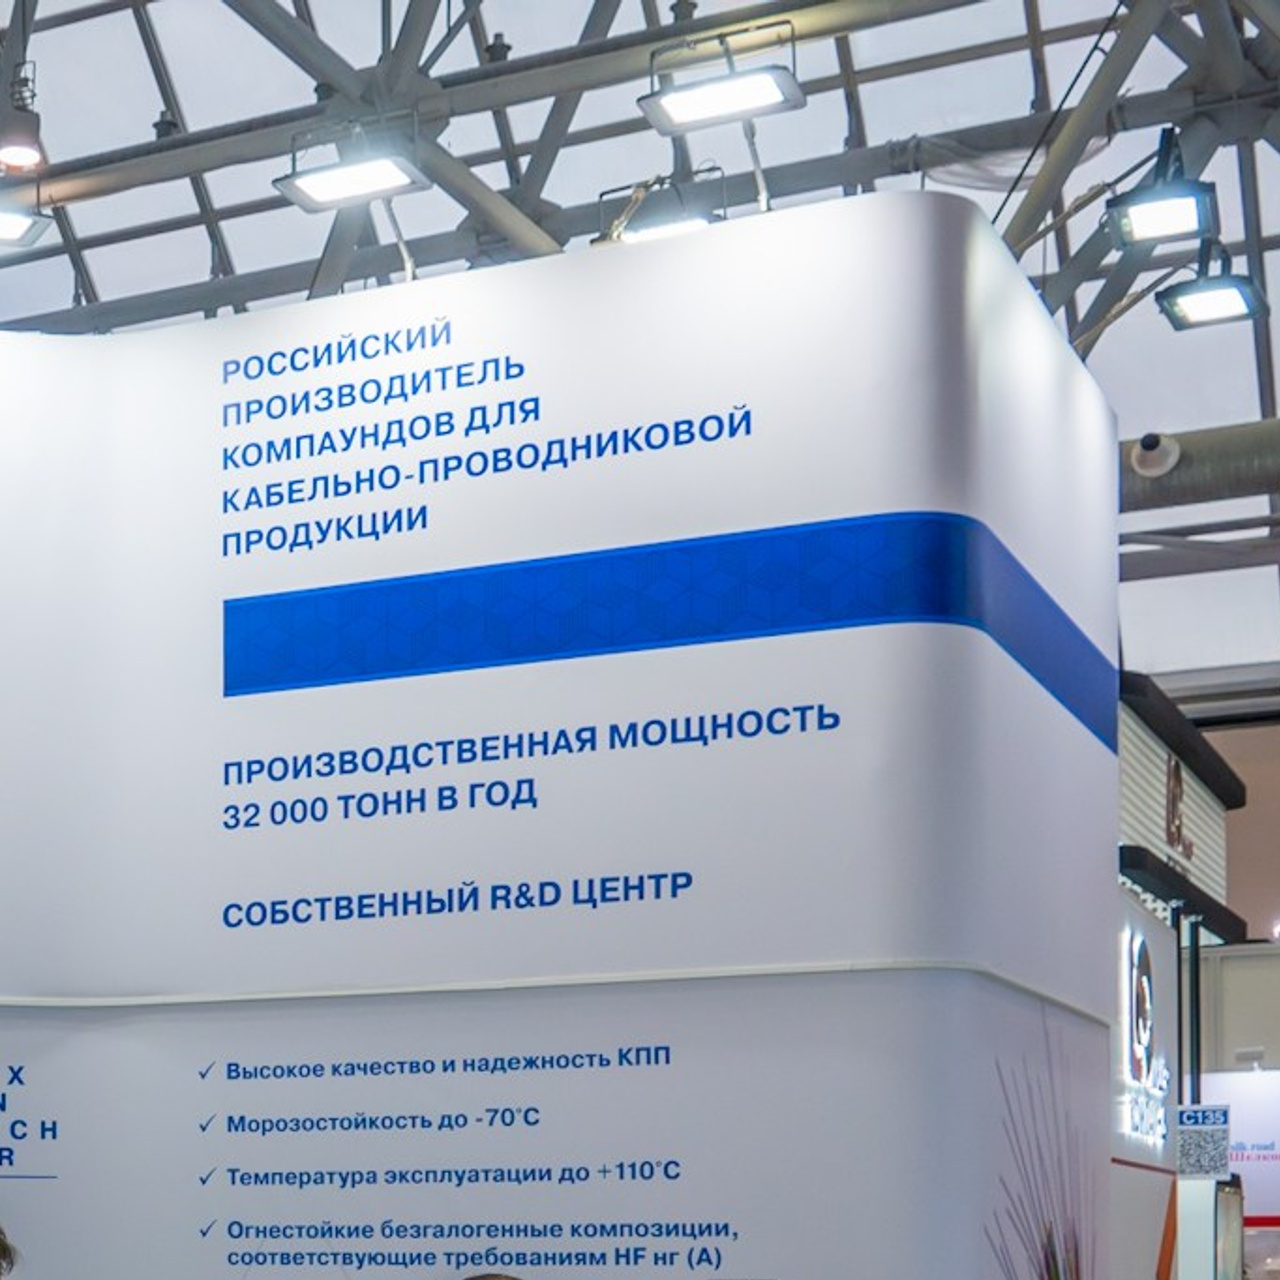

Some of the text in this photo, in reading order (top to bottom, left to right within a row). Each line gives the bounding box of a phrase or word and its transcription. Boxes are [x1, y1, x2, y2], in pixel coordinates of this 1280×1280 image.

[222, 317, 452, 383] РОССИЙСКИЙ
[222, 355, 526, 428] ПРОИЗВОДИТЕЛЬ
[222, 397, 539, 470] КОМПАУНДОВ ДЛЯ
[222, 405, 752, 513] КАБЕЛЬНО-ПРОВОДНИКОВОЙ
[222, 504, 427, 556] ПРОДУКЦИИ
[223, 704, 840, 786] ПРОИЗВОДСТВЕННАЯ МОЩНОСТЬ
[223, 779, 537, 829] 32 000 ТОНН В ГОД
[223, 872, 692, 928] СОБСТВЕННЫЙ R&D ЦЕНТР
[227, 1046, 670, 1080] Высокое качество и надежность КПП
[227, 1113, 432, 1136] Морозостойкость
[438, 1114, 468, 1131] до
[227, 1168, 377, 1189] Температура
[384, 1168, 552, 1187] эксплуатации
[558, 1167, 589, 1184] до
[227, 1219, 738, 1241] Огнестойкие безгалогенные композиции,
[227, 1252, 437, 1270] соответствующие
[443, 1247, 606, 1270] требованиям
[615, 1247, 646, 1265] HF
[654, 1252, 679, 1265] нг
